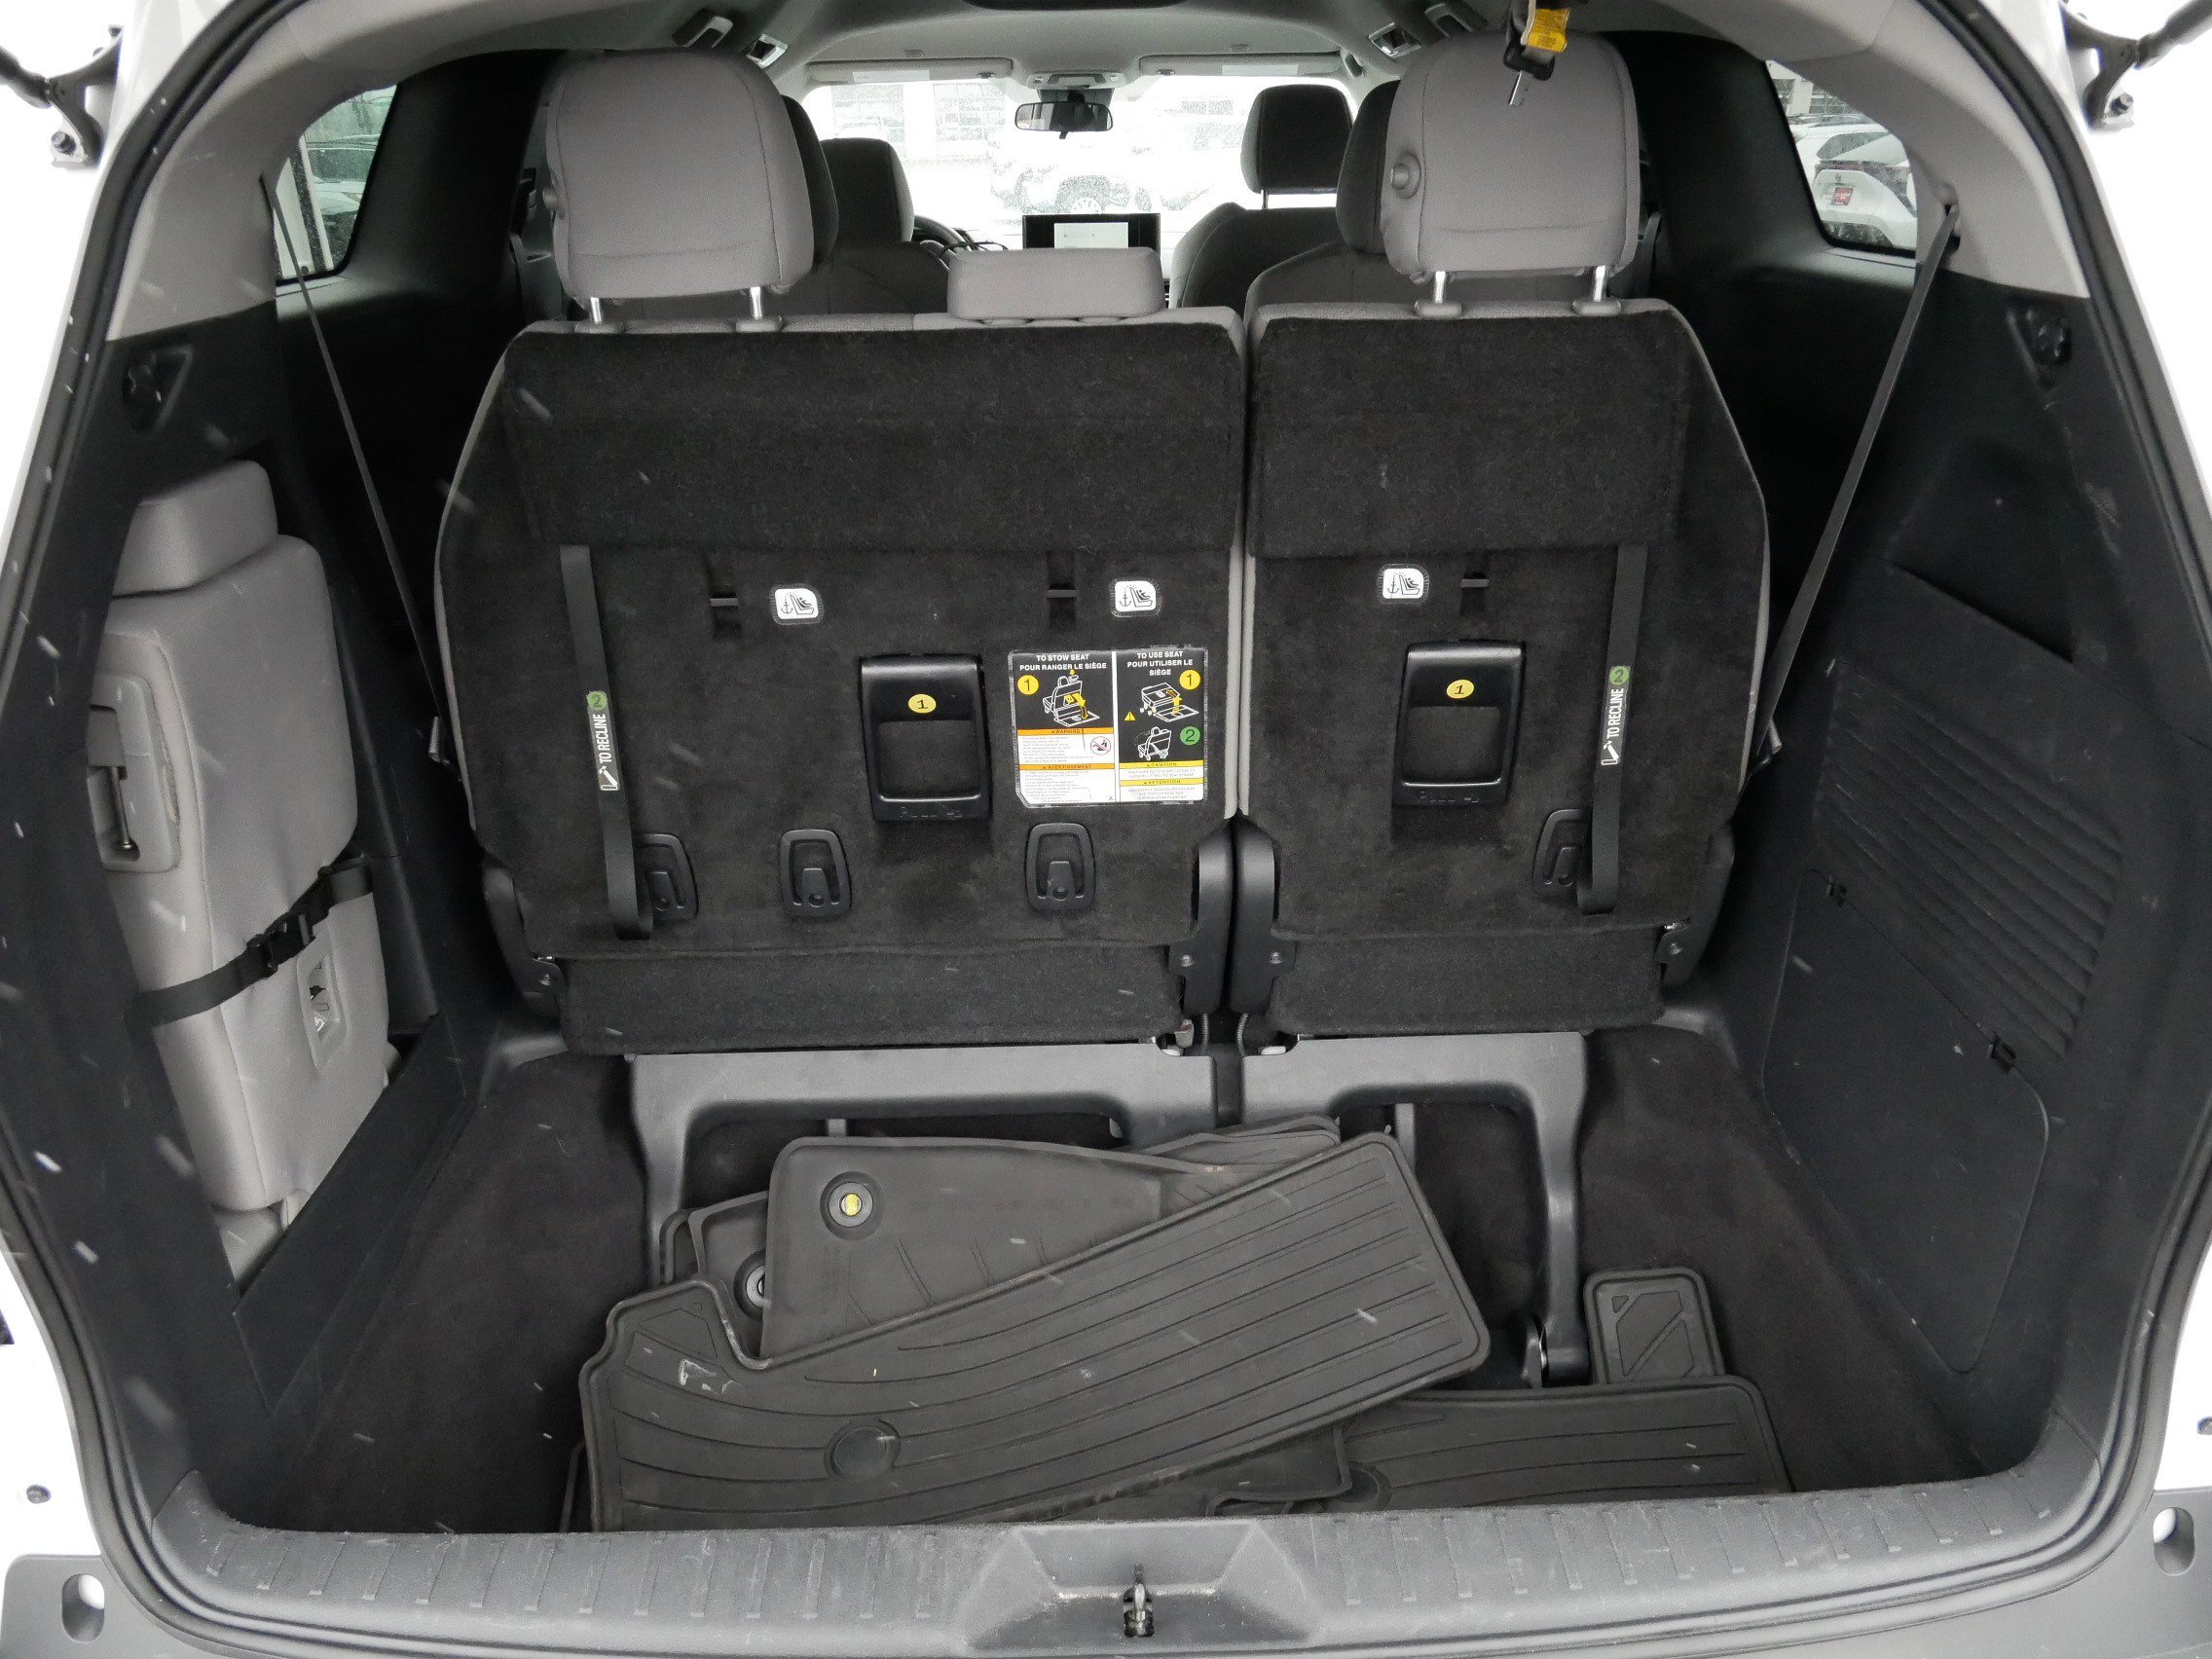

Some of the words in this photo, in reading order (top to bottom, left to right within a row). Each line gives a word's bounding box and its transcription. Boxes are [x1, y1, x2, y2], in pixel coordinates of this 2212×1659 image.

[1186, 673, 1193, 687] 1
[1613, 668, 1624, 683] 2
[1023, 678, 1030, 692] 1
[1454, 684, 1464, 695] 1
[591, 693, 603, 709] 2
[916, 699, 928, 710] 1
[1608, 687, 1624, 725] RECLINE
[593, 714, 609, 751] RECLINE
[1185, 728, 1196, 742] 2
[1606, 726, 1620, 740] TO
[599, 752, 612, 764] TO
